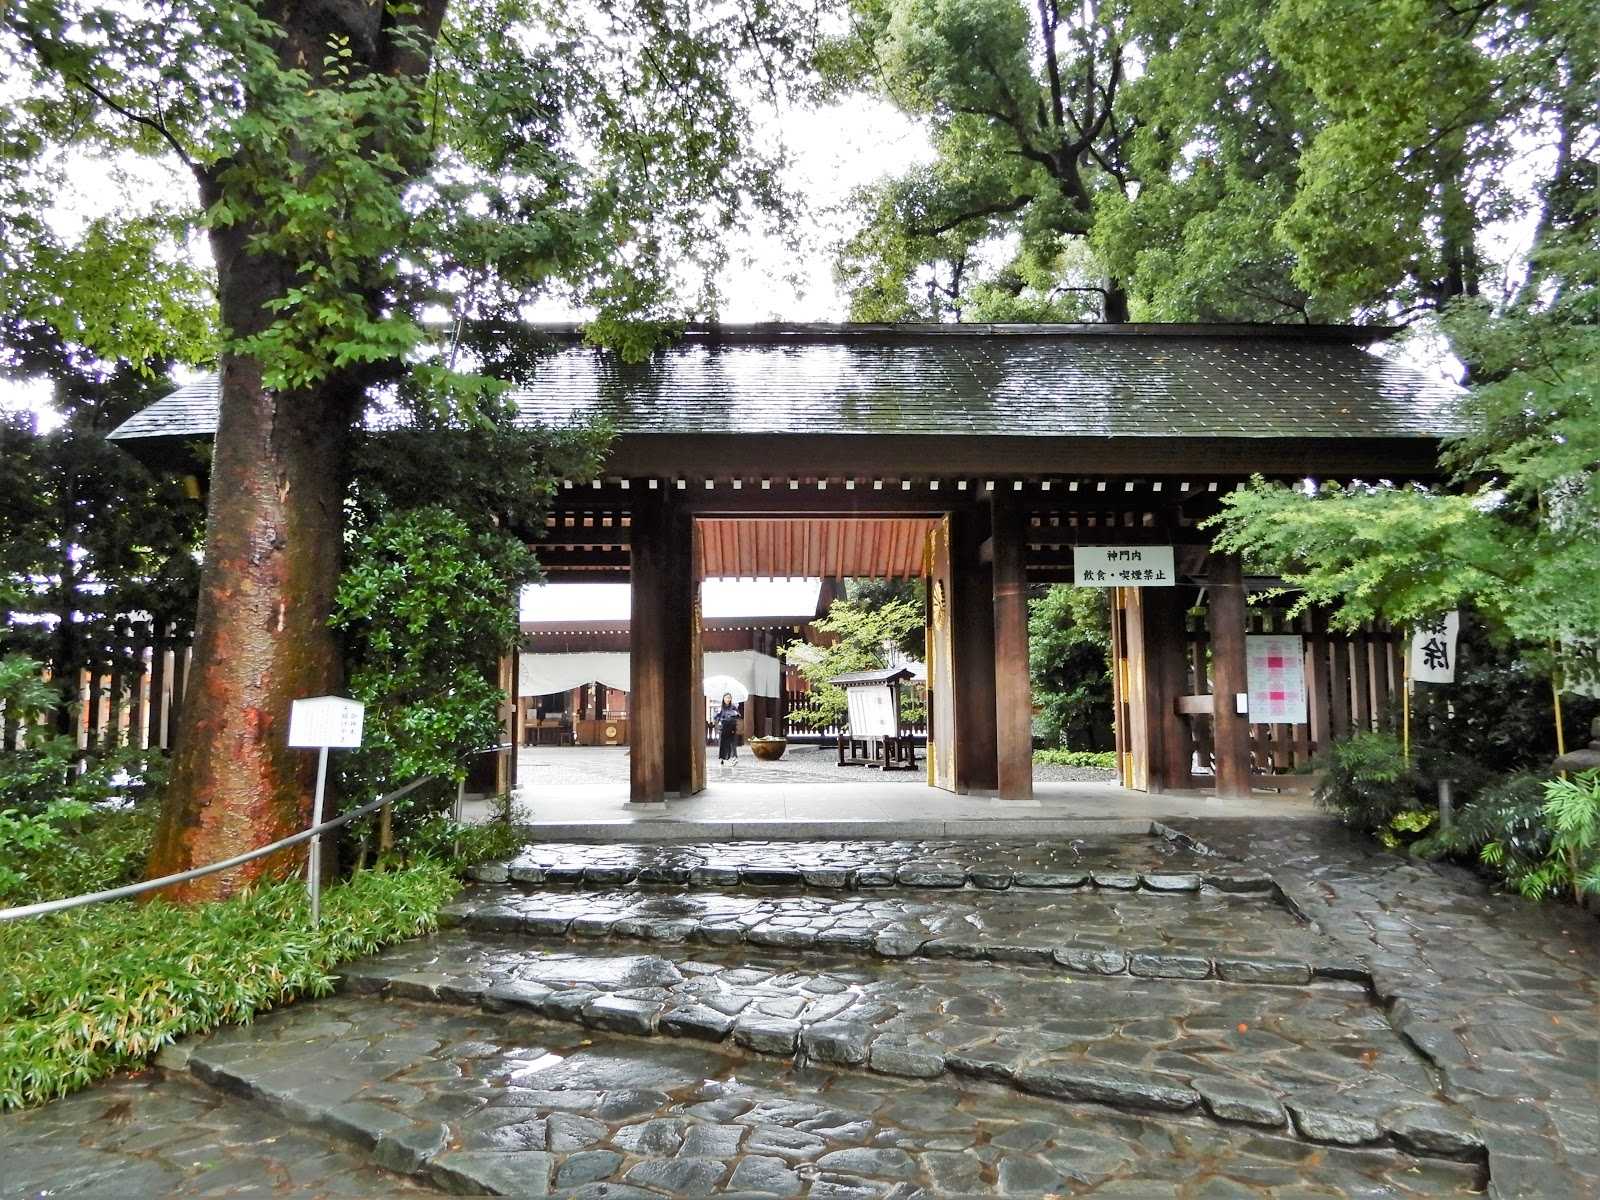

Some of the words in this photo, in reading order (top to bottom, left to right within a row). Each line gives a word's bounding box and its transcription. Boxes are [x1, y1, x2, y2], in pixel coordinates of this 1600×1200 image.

[1107, 550, 1142, 561] 神門内
[1083, 569, 1166, 581] 飲食・喫煙禁止
